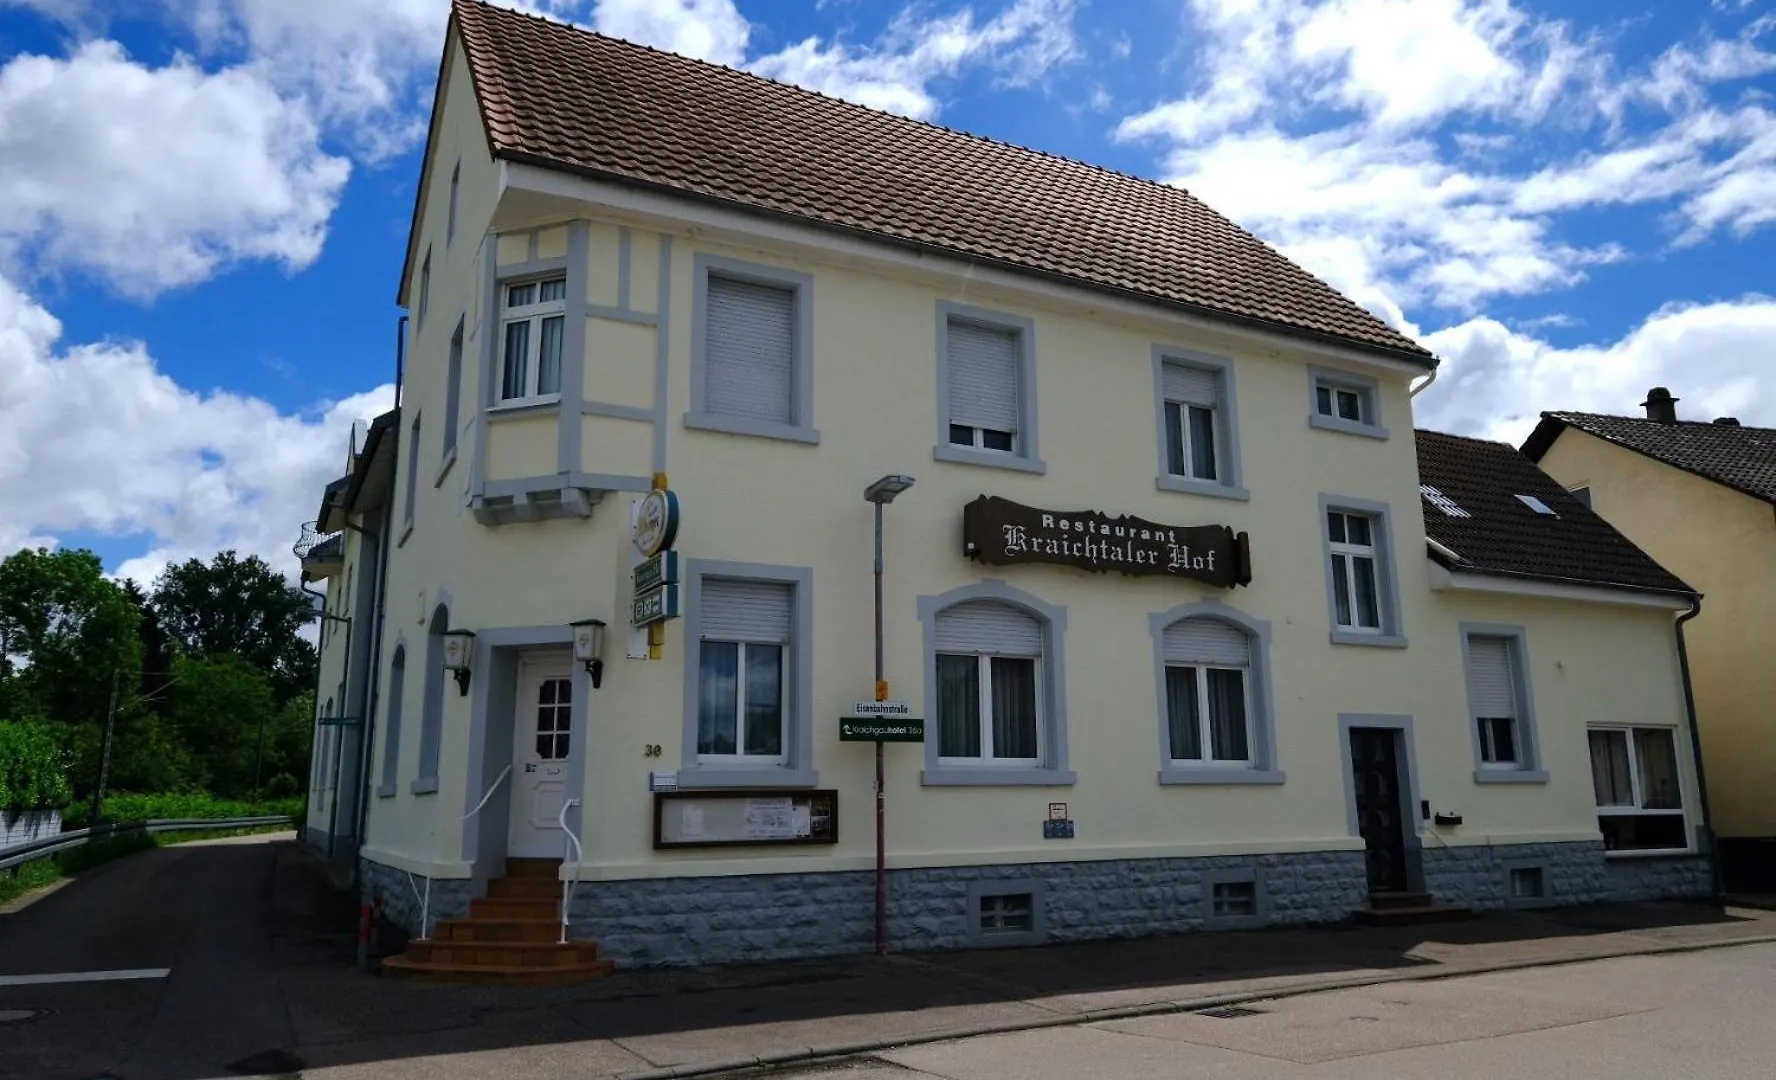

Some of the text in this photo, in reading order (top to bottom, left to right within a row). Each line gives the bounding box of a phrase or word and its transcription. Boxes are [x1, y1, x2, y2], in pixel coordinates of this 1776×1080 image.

[1042, 513, 1177, 543] Restaurant
[1003, 524, 1217, 573] Kraichtaler Hof
[856, 703, 907, 713] Eisenbahnstraße
